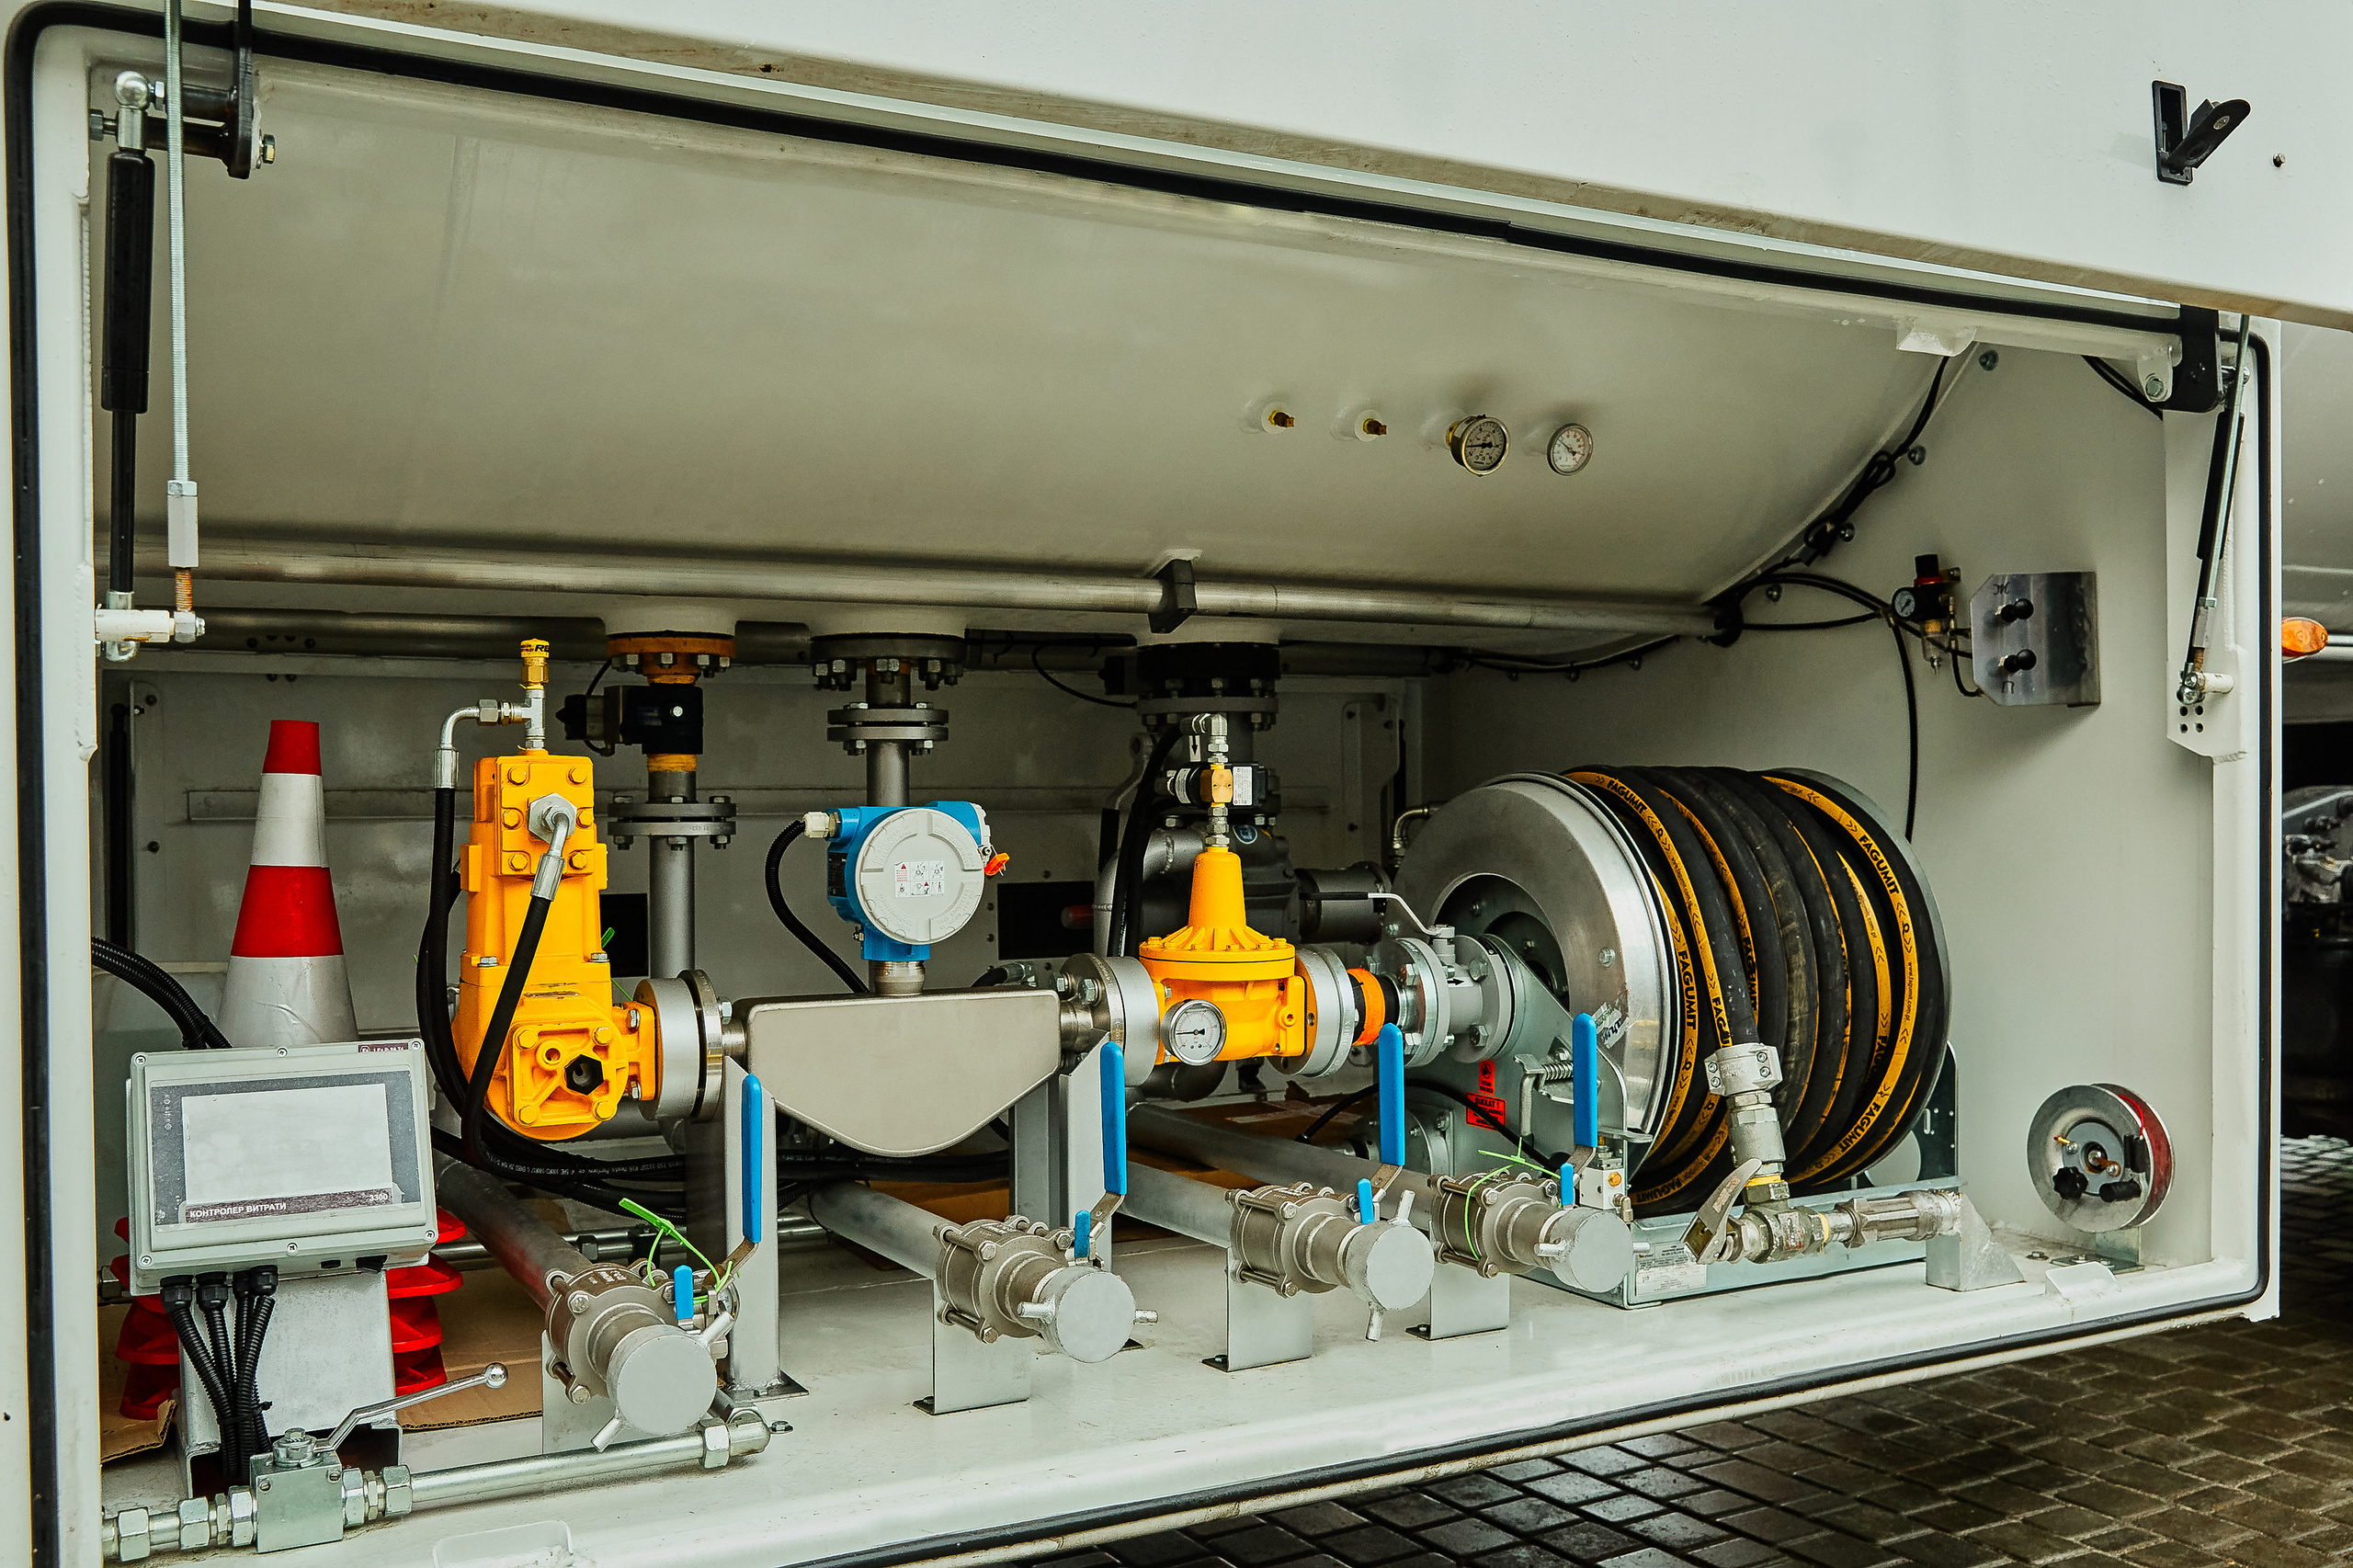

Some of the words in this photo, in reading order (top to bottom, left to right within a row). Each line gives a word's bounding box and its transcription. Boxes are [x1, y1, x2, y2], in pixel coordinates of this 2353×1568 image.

[1607, 779, 1648, 814] FAGUMIT
[1859, 835, 1900, 894] FAGUMIT
[1678, 949, 1697, 1030] FAGUMIT
[1838, 1101, 1881, 1153] FAGUMIT
[369, 1192, 389, 1202] 3300
[1637, 1178, 1683, 1203] FAGUMIT
[189, 1206, 244, 1219] КОНТРОЛЕР
[245, 1202, 287, 1214] ВИТРАТИ
